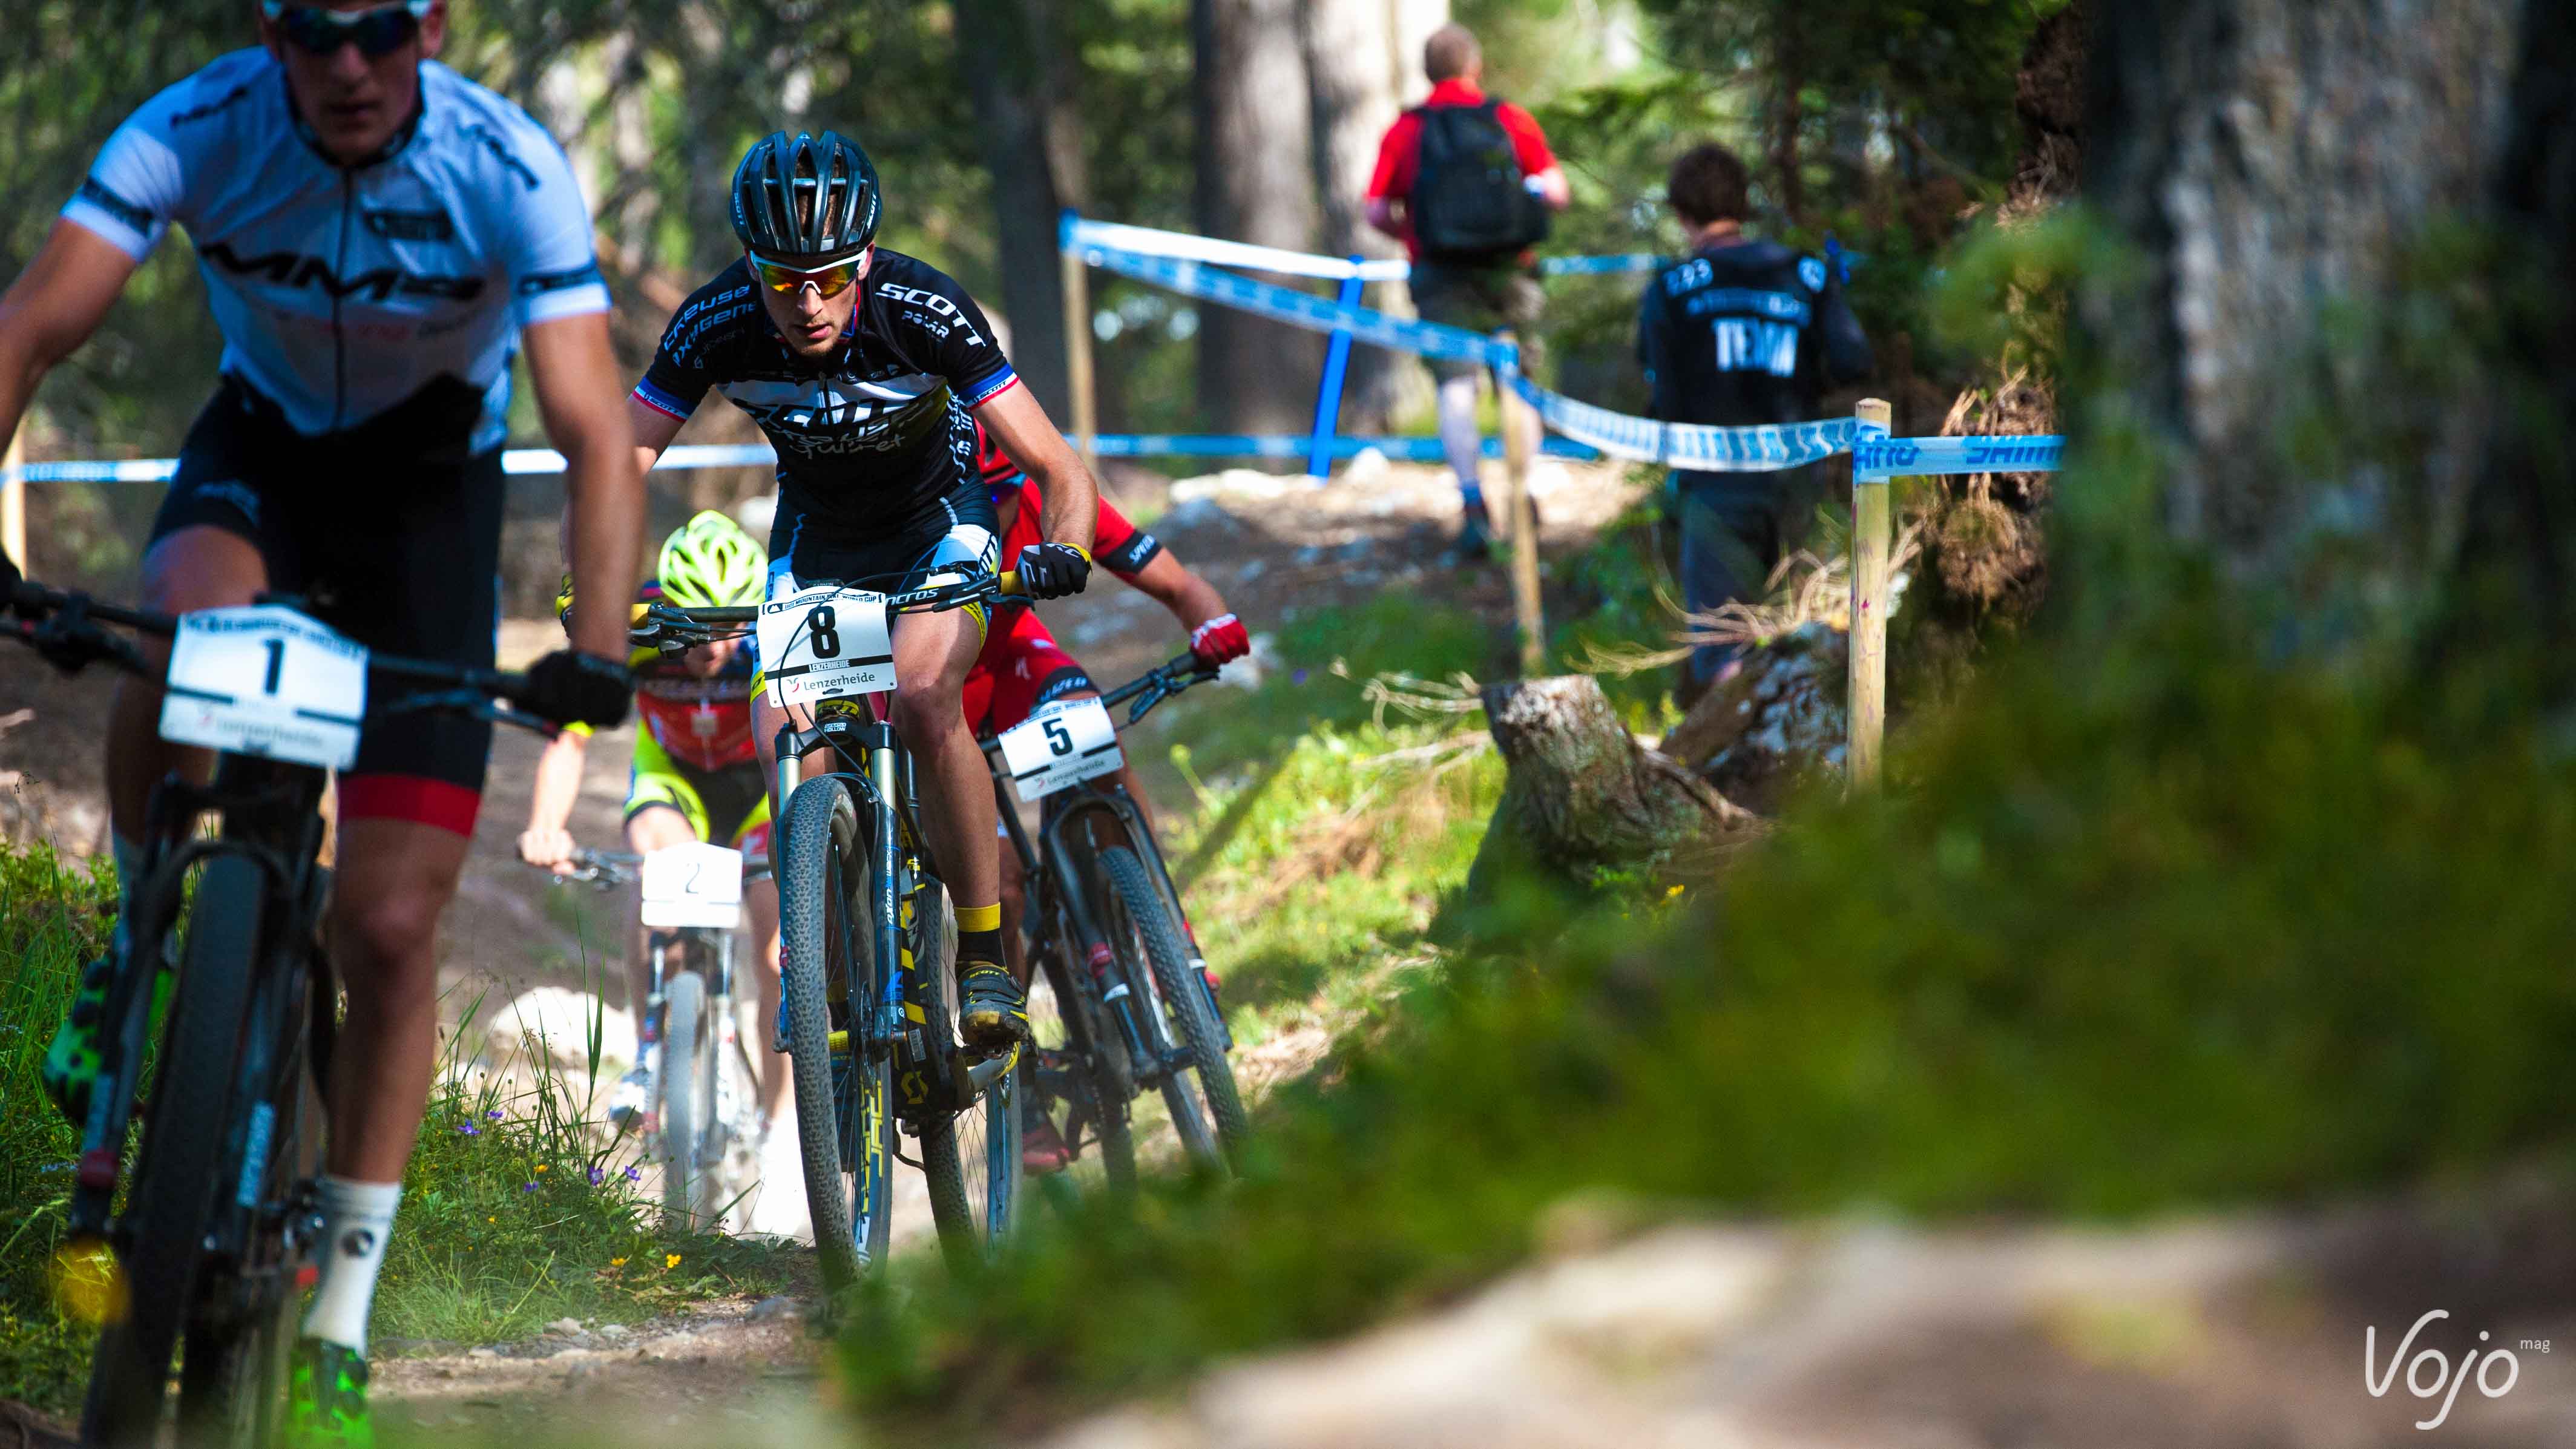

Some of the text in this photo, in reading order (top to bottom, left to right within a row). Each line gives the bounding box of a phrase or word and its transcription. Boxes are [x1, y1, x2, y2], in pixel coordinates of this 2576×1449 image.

[875, 283, 986, 347] SCOTT
[980, 381, 1007, 398] SCOTT
[796, 594, 825, 604] MOUNTAIN
[808, 606, 840, 659] 8
[263, 639, 284, 694] 1
[804, 672, 876, 691] Lenzerheide
[809, 659, 850, 672] LENZERHEIDE
[1042, 718, 1073, 756] 5
[685, 862, 701, 894] 2
